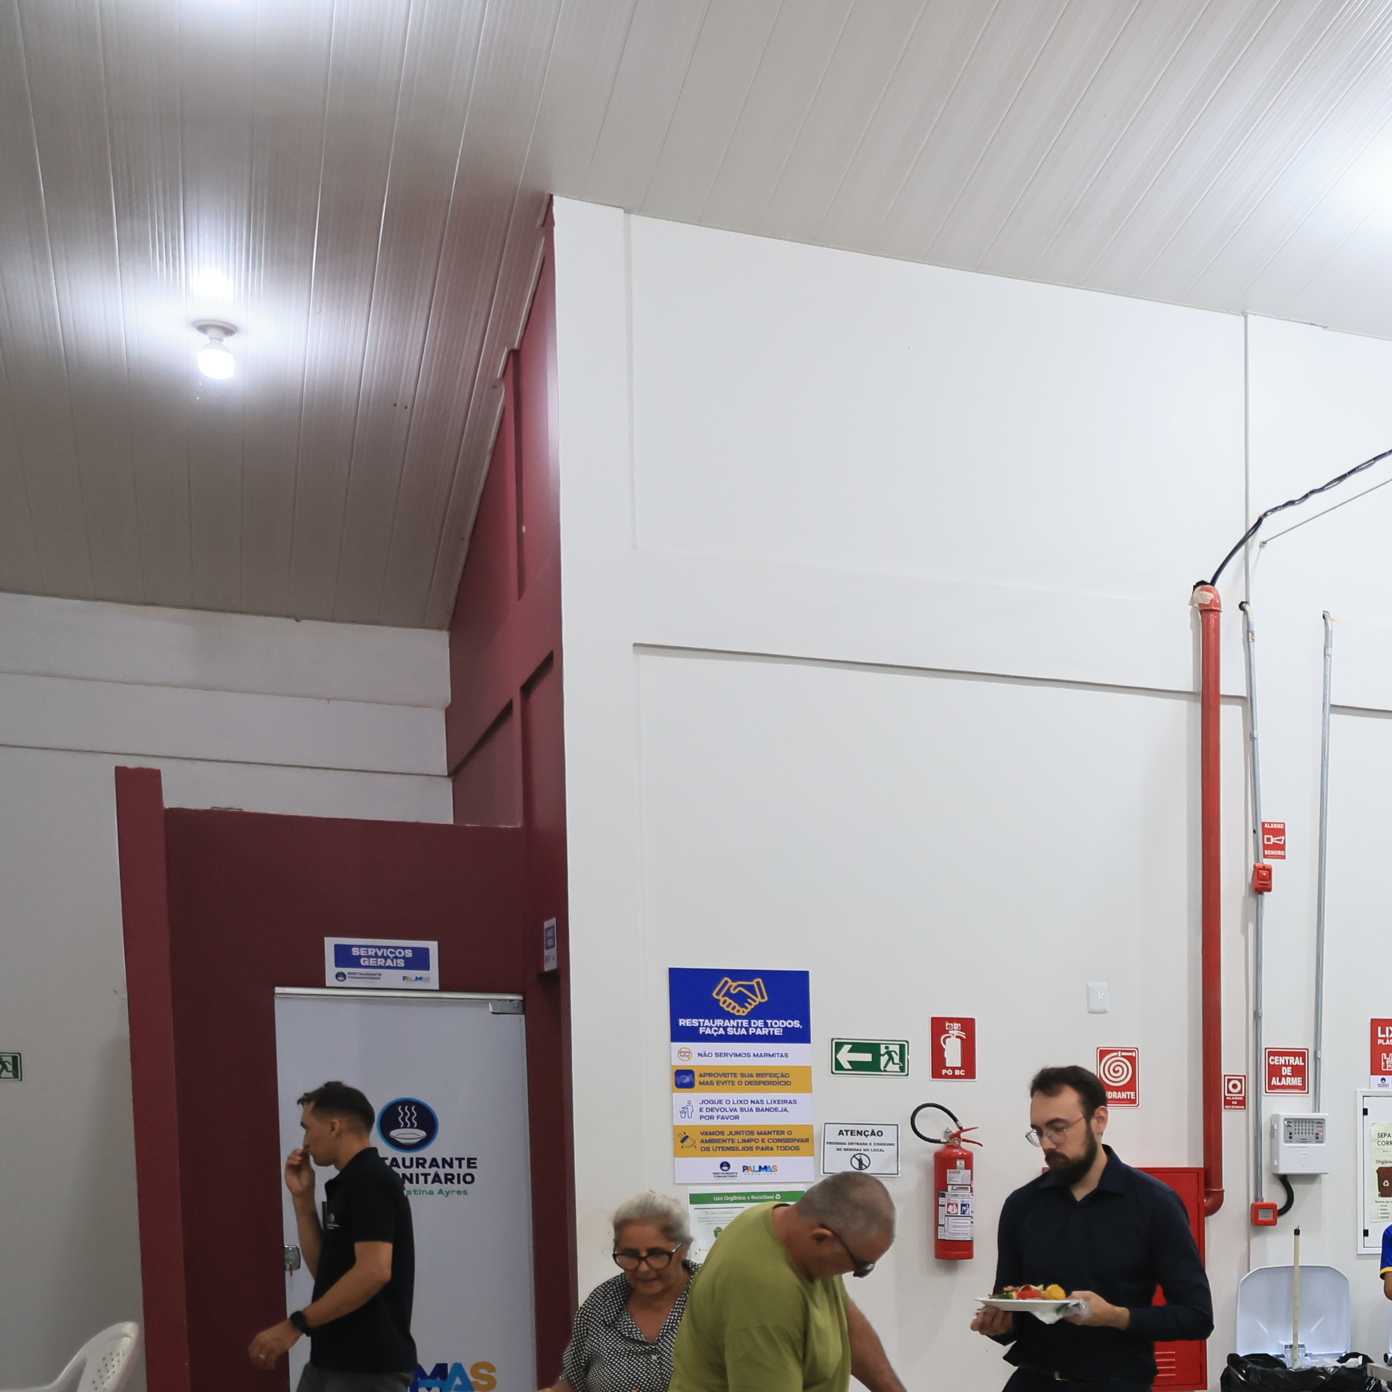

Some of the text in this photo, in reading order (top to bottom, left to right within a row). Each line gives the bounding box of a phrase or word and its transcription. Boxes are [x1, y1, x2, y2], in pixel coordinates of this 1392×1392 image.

[352, 947, 413, 959] SERVIÇOS
[360, 958, 405, 967] GERAIS
[679, 1019, 803, 1029] RESTAURANTE DE TODOS,
[699, 1027, 783, 1037] FAÇA SUA PARTE!
[697, 1050, 713, 1058] NÃO
[1269, 1056, 1304, 1065] CENTRAL
[1281, 1066, 1292, 1075] DE
[1271, 1076, 1302, 1086] ALARME
[1106, 1091, 1135, 1099] IDRANTE
[838, 1129, 884, 1138] ATENÇÃO
[381, 1157, 478, 1169] TAURANTE
[742, 1165, 778, 1173] PALMAS
[401, 1171, 476, 1185] NITÁRIO
[437, 1188, 468, 1197] Ayres
